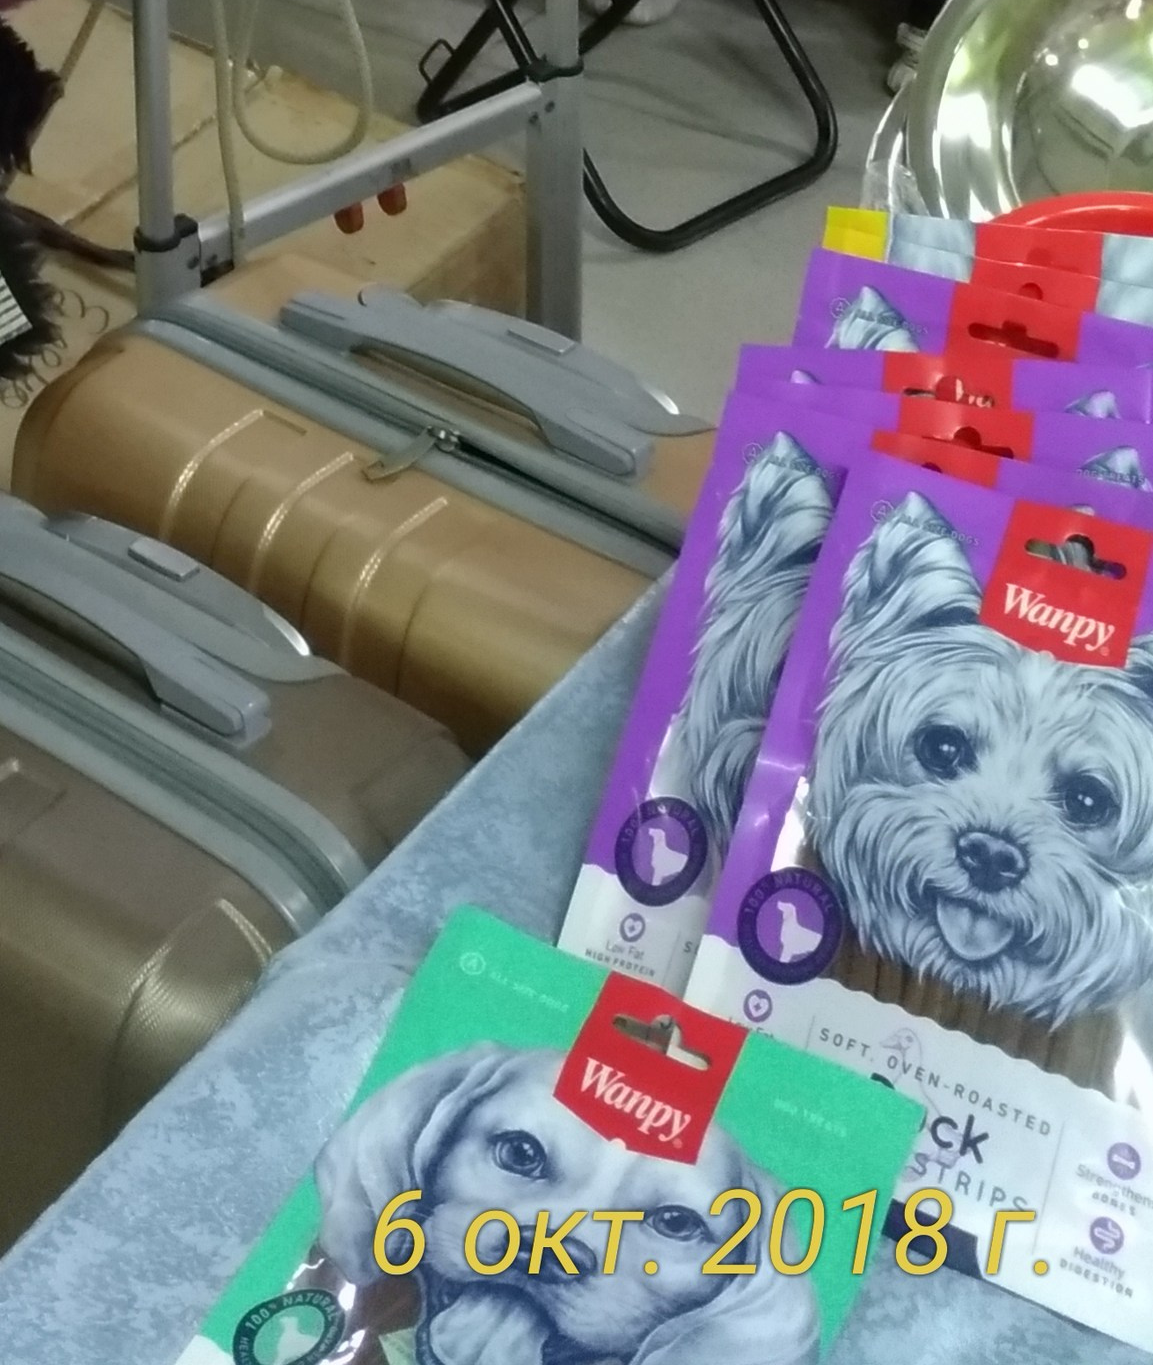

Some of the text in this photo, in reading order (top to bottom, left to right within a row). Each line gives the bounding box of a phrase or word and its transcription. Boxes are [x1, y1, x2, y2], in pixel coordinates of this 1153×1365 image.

[1004, 582, 1116, 652] Wanpy
[580, 1056, 692, 1142] Wanpy
[887, 1055, 1053, 1136] OVEN-ROASTED
[282, 1291, 340, 1322] NATURAL
